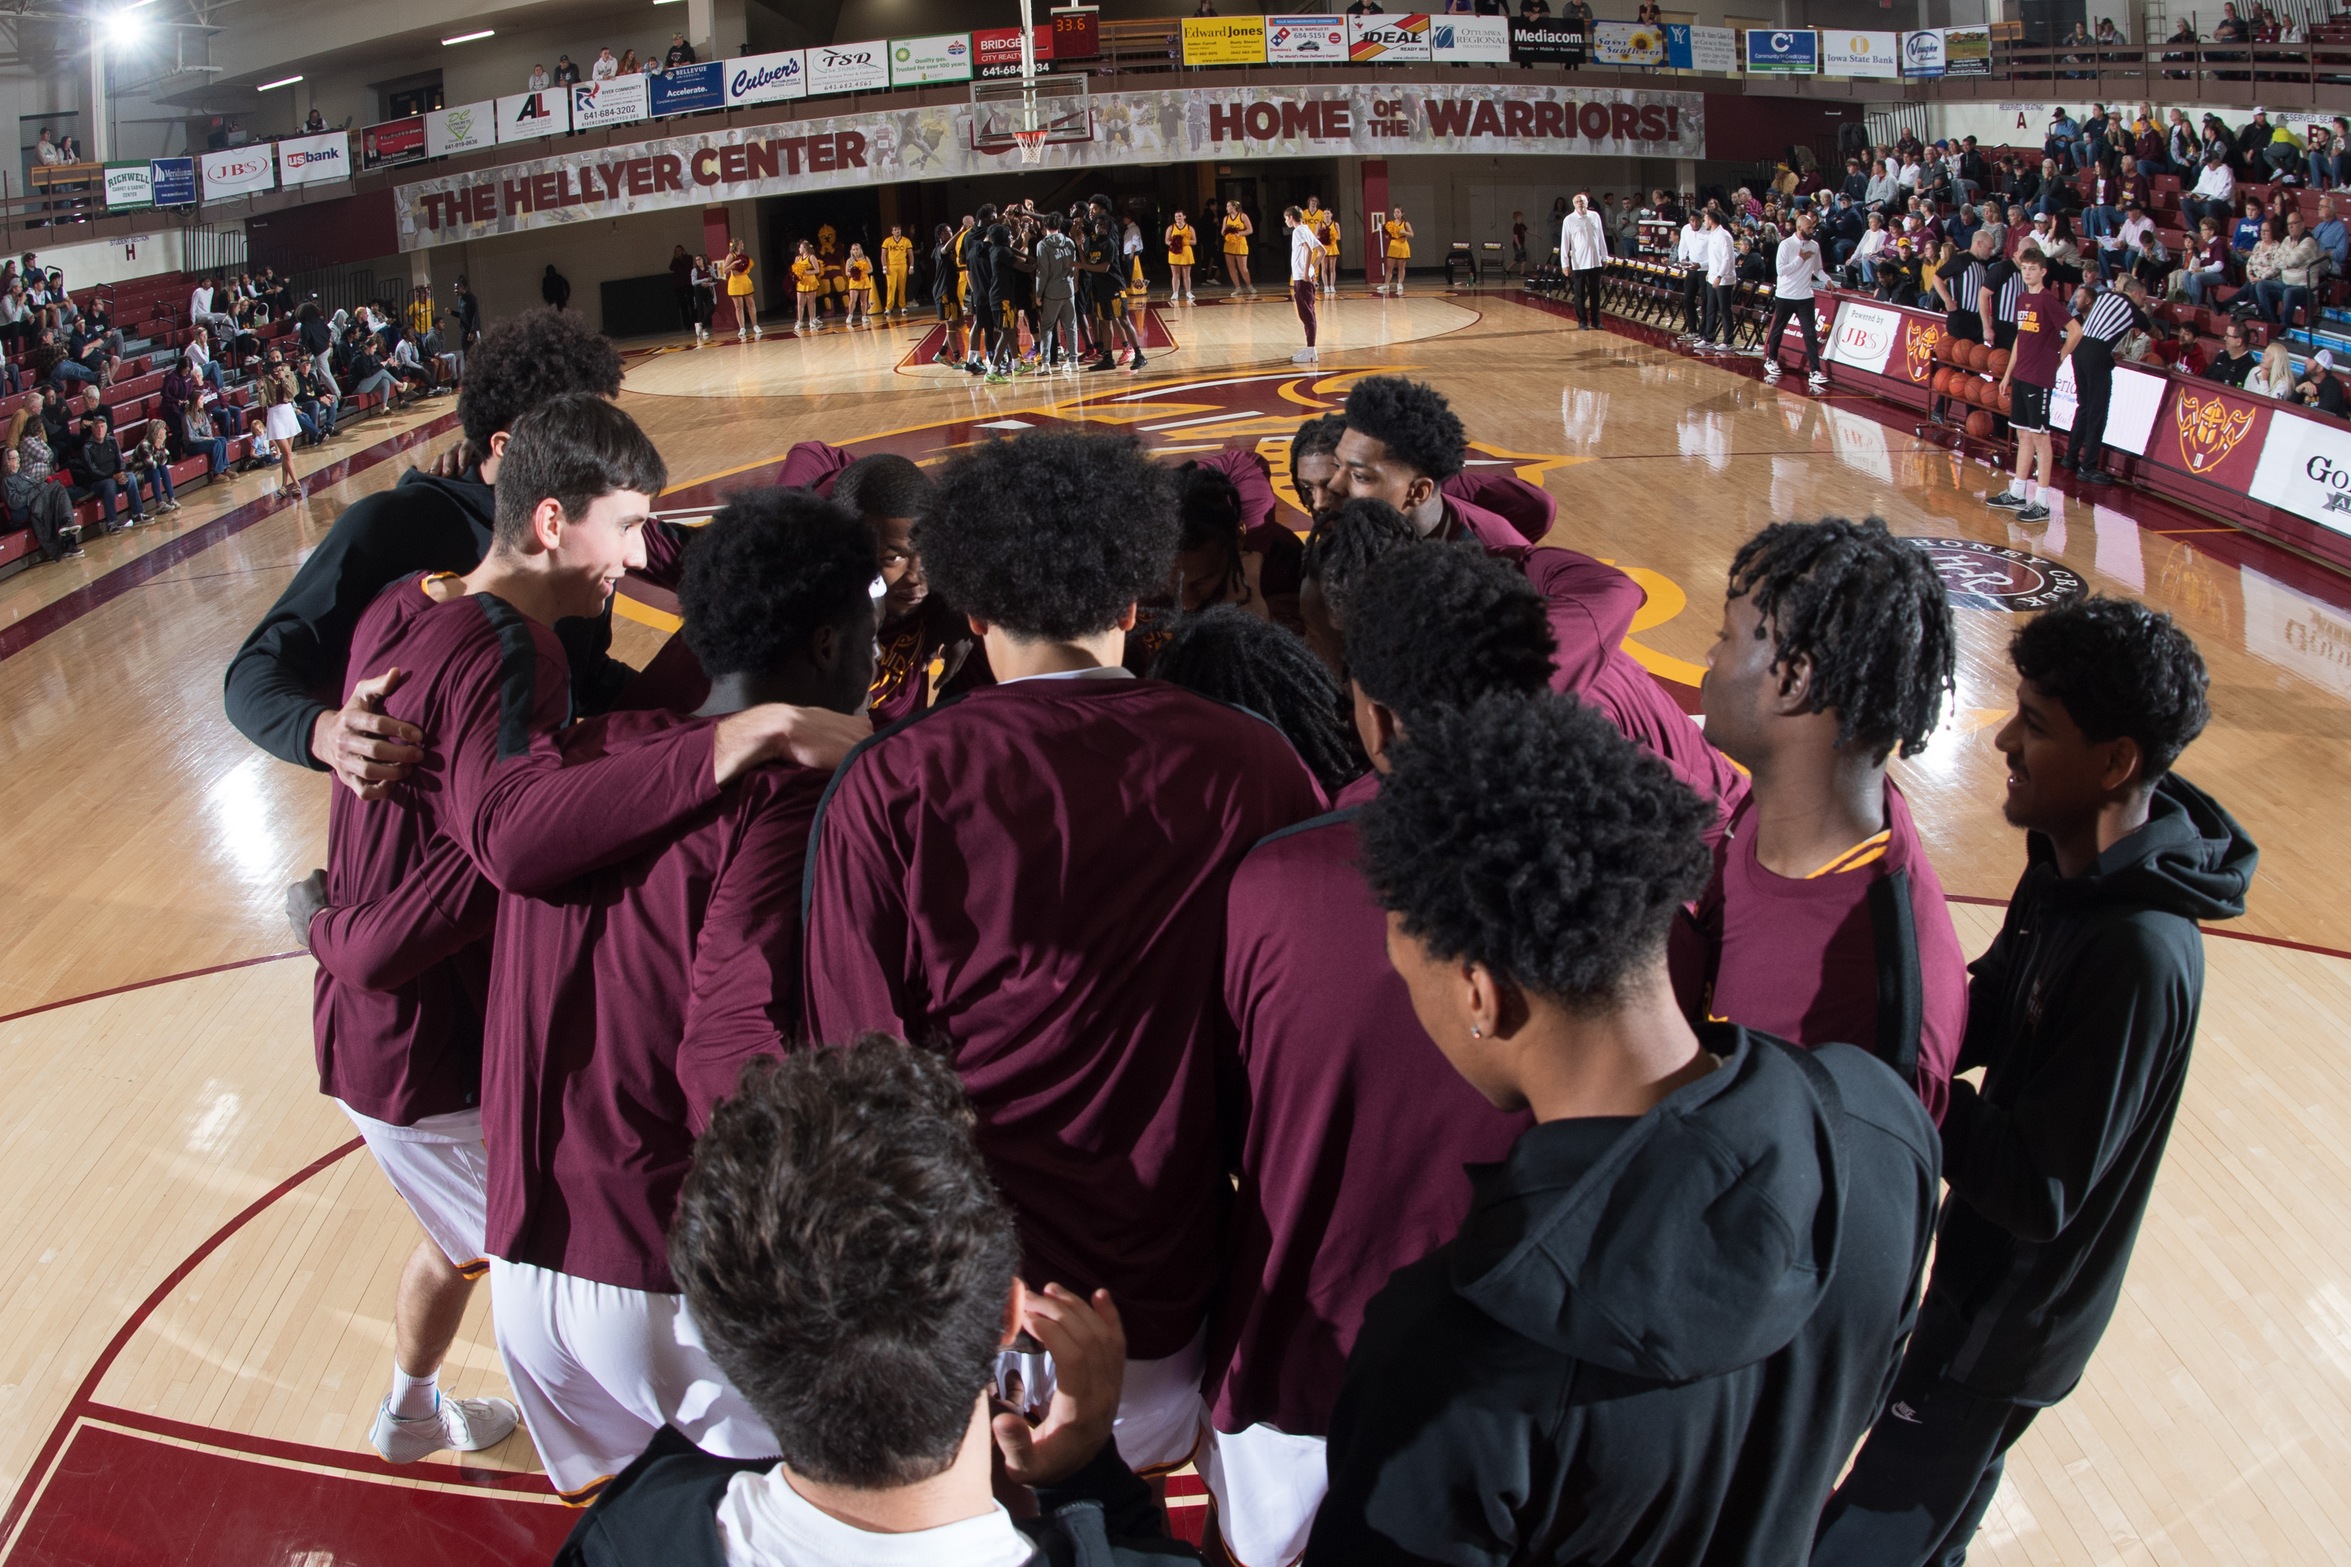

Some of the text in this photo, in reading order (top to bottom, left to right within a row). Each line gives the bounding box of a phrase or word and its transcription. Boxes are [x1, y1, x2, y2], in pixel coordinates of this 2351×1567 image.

[1057, 18, 1086, 31] 33.6
[1184, 26, 1263, 38] Edward Jones
[980, 38, 1022, 50] BRIDGE
[1362, 32, 1422, 43] IDEAL
[1514, 29, 1582, 43] Mediacom
[1599, 38, 1660, 56] Sassy Sunflower
[1911, 38, 1938, 56] Vaughn
[823, 52, 871, 67] TSD
[1849, 55, 1870, 63] State
[1872, 55, 1894, 64] Bank
[676, 66, 707, 75] BELLEVUE
[731, 57, 800, 97] Culver's
[667, 86, 708, 97] Accelerate.
[824, 81, 872, 90] 641.682.4561
[448, 109, 471, 122] DC
[516, 93, 550, 122] AL
[584, 105, 636, 120] 641-684-3202
[1373, 100, 1401, 117] OF
[1209, 100, 1350, 142] HOME
[1424, 100, 1680, 142] WARRIORS!
[2017, 112, 2027, 129] A
[2280, 113, 2316, 122] RESERVED
[1367, 119, 1409, 137] THE
[2308, 124, 2321, 146] B
[216, 161, 257, 179] JBS
[107, 173, 150, 188] RICHWELL
[420, 130, 868, 230] THE HELLYER CENTER
[126, 243, 136, 260] H
[1851, 310, 1884, 325] Powered by
[1842, 328, 1880, 350] JBS
[1907, 539, 2050, 566] HONEY
[1896, 1401, 1916, 1418] NIKE
